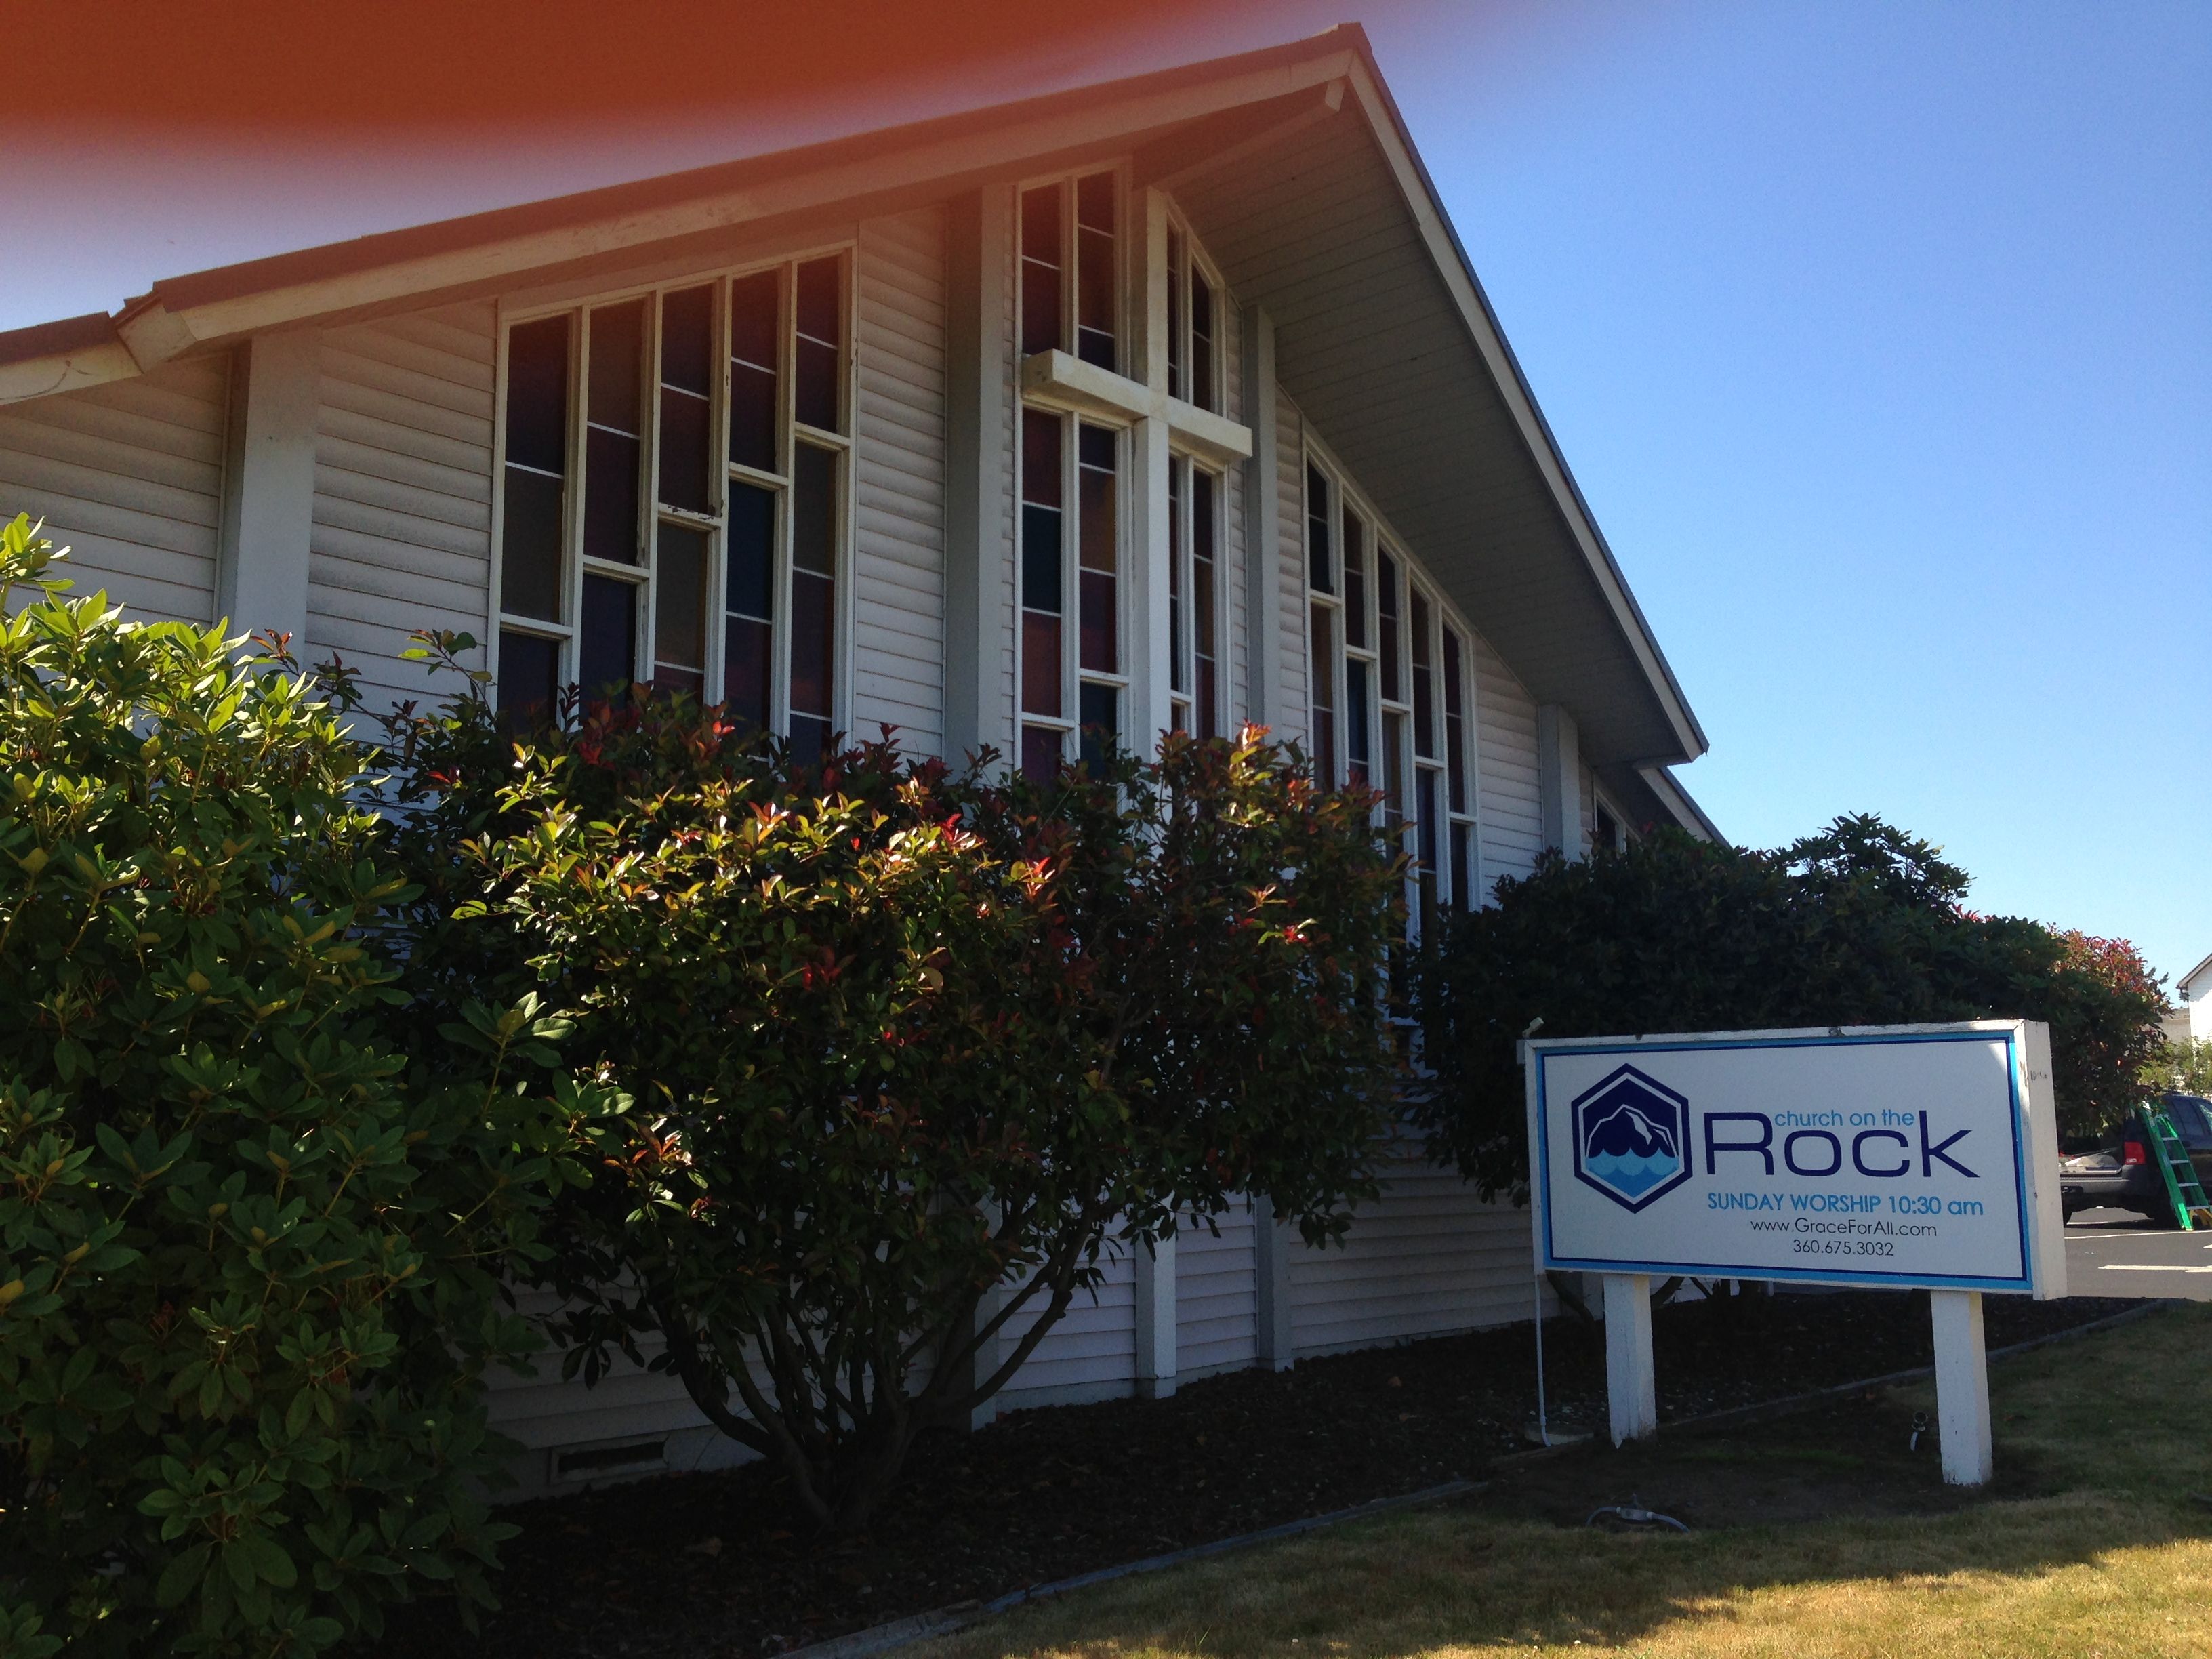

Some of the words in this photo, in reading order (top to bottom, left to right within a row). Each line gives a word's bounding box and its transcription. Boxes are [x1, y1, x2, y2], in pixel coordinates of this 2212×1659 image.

[1774, 1110, 1843, 1126] church
[1849, 1113, 1877, 1126] on
[1882, 1109, 1916, 1126] the
[1703, 1109, 1981, 1178] Rock
[1707, 1192, 1784, 1211] SUNDAY
[1790, 1194, 1881, 1213] WORSHIP
[1889, 1195, 1942, 1215] 10:30
[1947, 1199, 1984, 1216] am
[1750, 1217, 1938, 1237] www.GraceForAll.com
[1793, 1239, 1895, 1256] 360.675.3032
